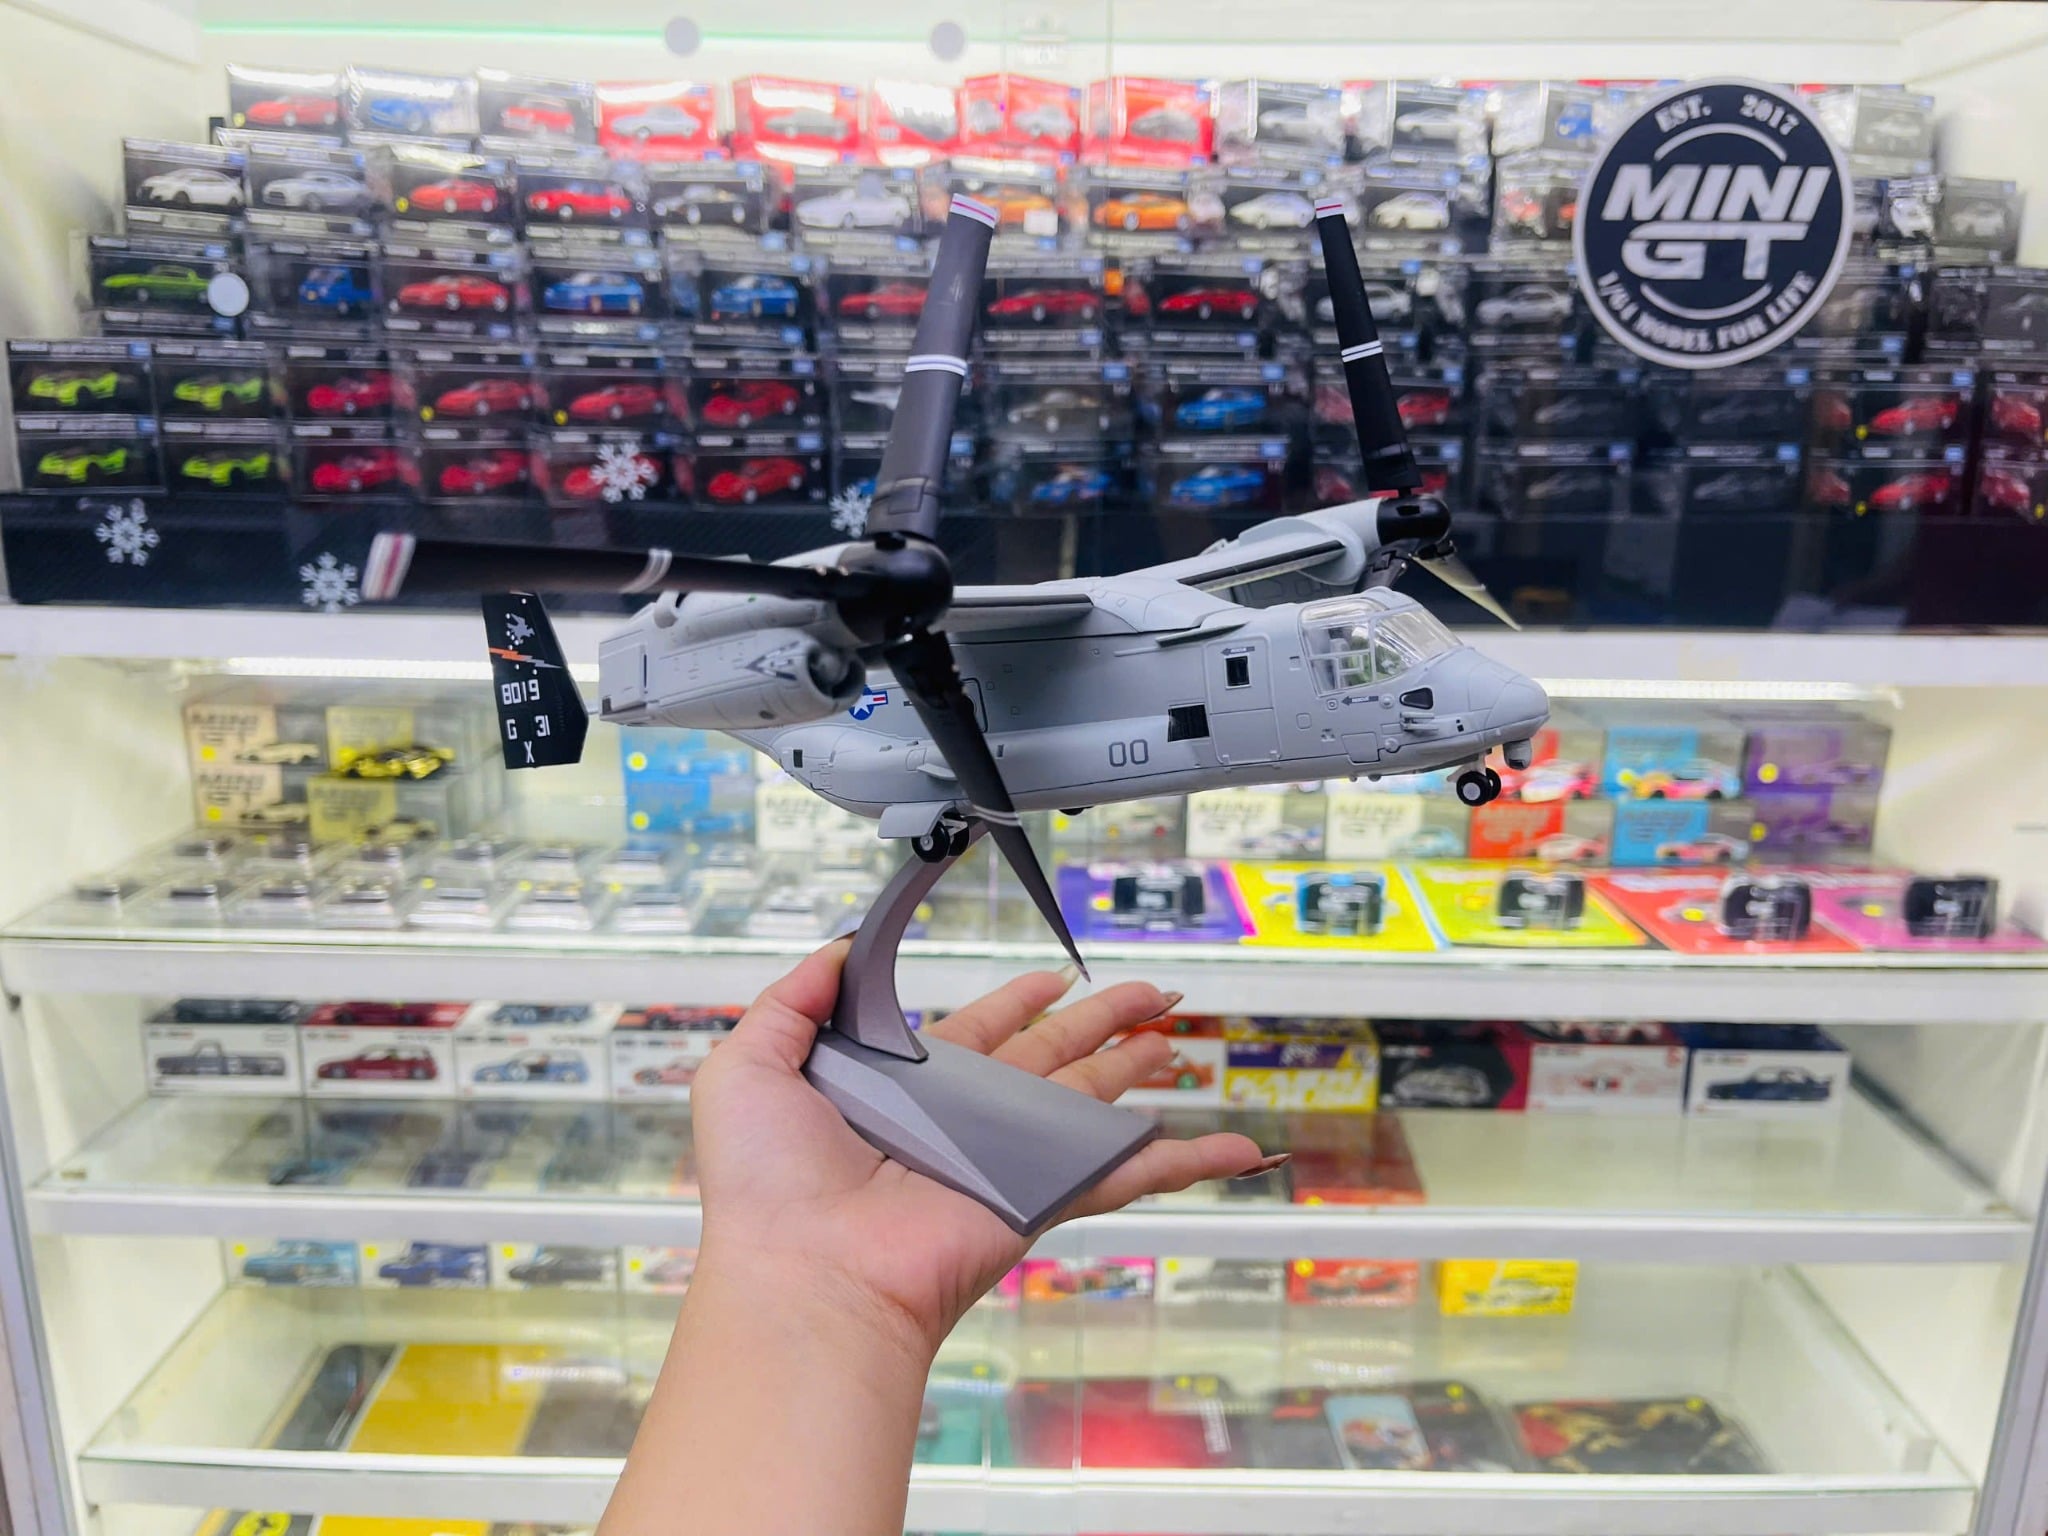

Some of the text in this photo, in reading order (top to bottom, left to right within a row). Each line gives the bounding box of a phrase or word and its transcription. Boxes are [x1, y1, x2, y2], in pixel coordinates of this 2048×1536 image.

[1654, 94, 1799, 136] EST. 2017
[1602, 163, 1832, 222] MINI
[1621, 220, 1809, 281] GT
[1632, 311, 1714, 351] MODEL
[1716, 314, 1768, 350] FOR
[1765, 270, 1818, 325] LIFE
[501, 679, 540, 705] 8019
[506, 714, 551, 741] G 31
[523, 740, 535, 763] X
[1108, 739, 1149, 767] 00
